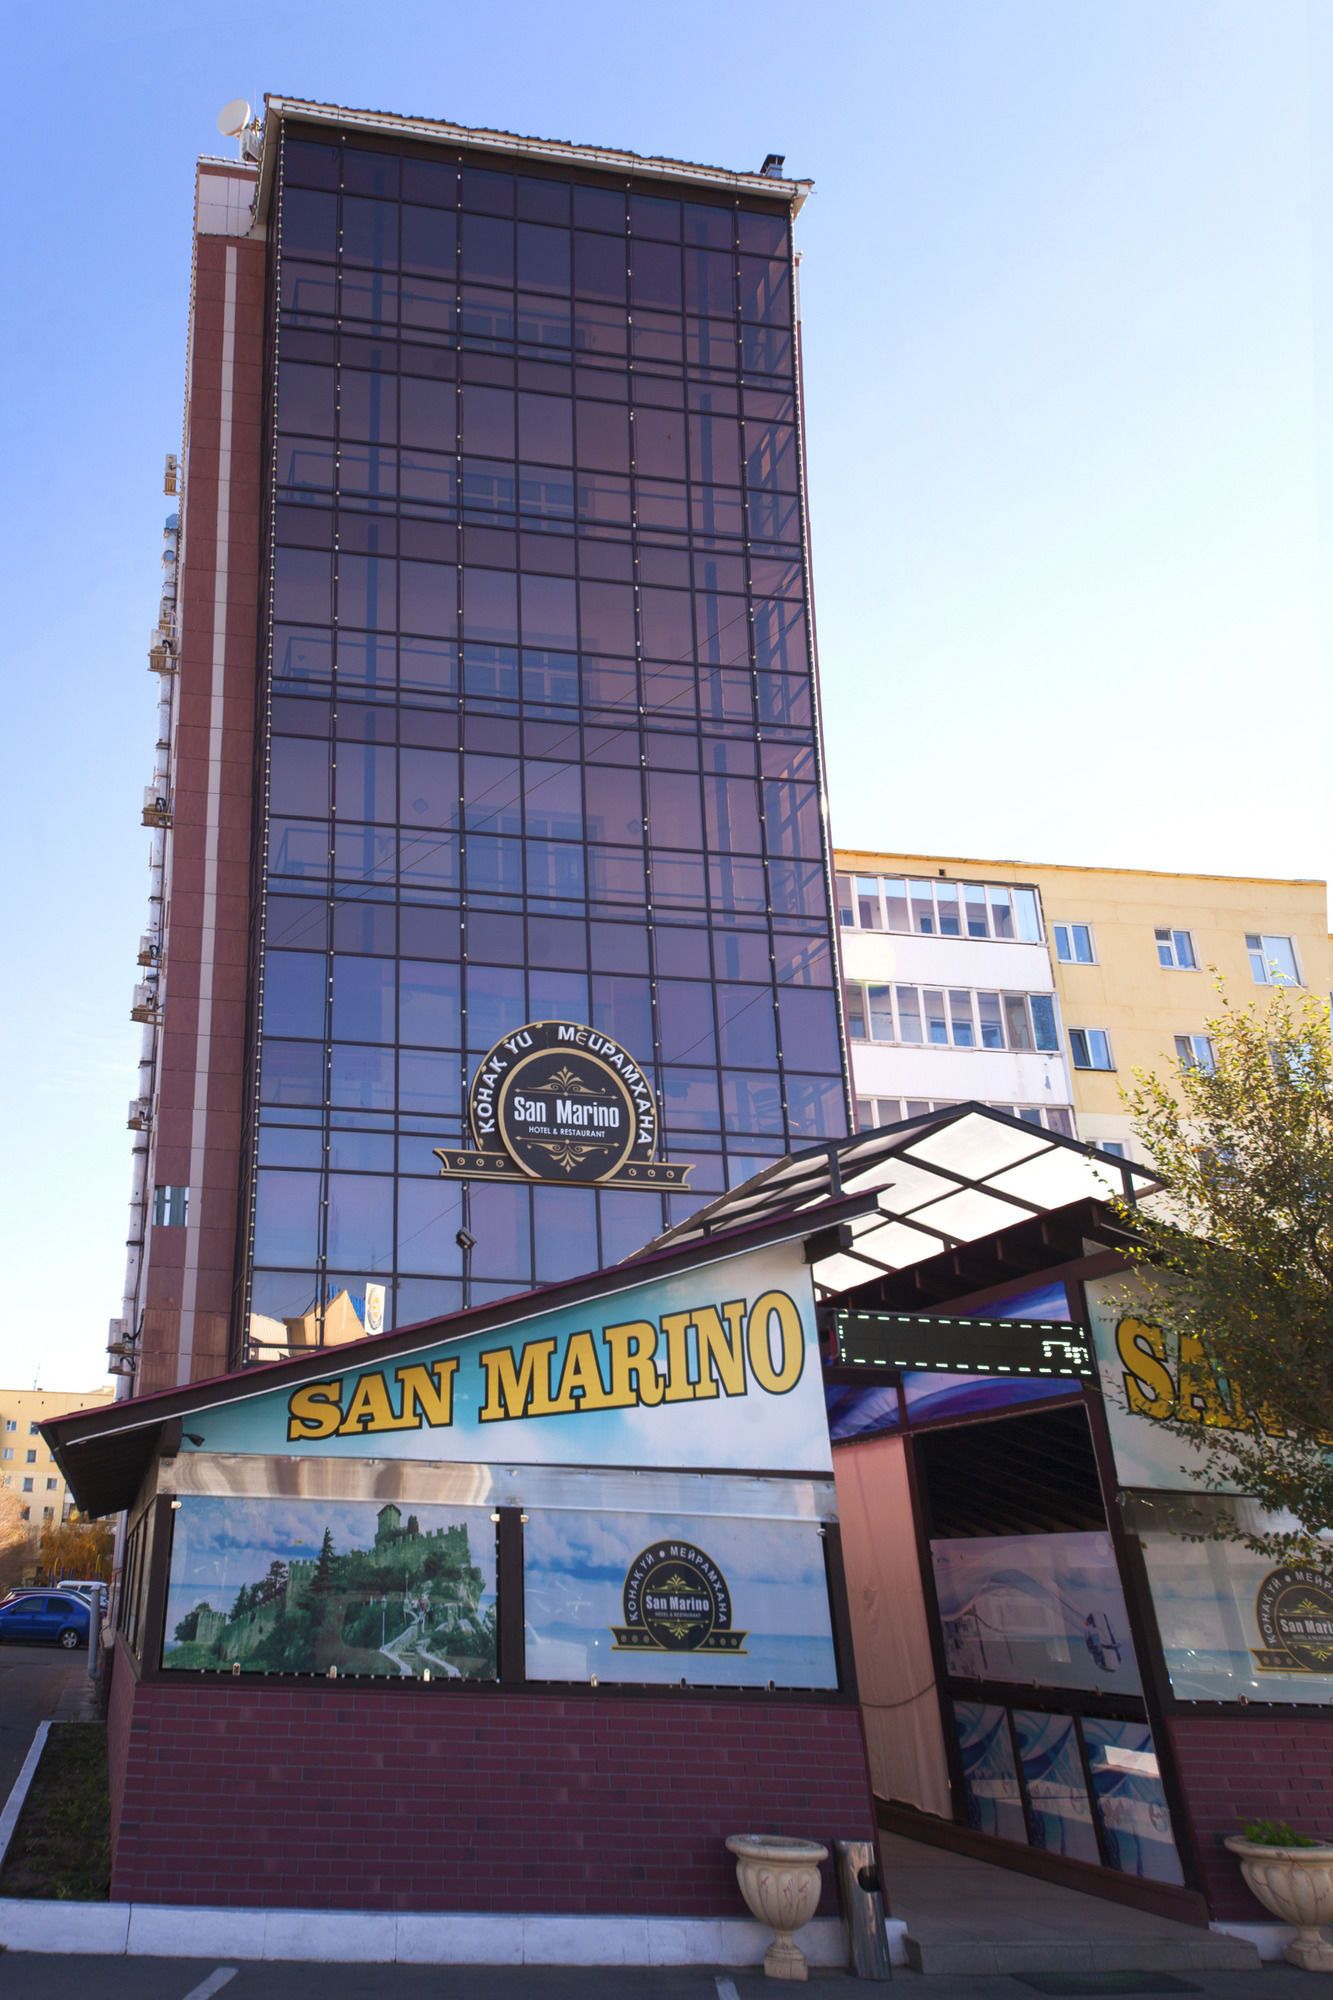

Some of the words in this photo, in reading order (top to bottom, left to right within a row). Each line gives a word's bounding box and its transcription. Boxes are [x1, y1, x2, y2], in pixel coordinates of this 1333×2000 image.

[514, 1096, 546, 1123] San
[556, 1099, 620, 1128] Marino
[528, 1126, 551, 1135] HOTEL
[560, 1128, 606, 1138] RESTAURANT
[286, 1357, 460, 1442] SAN
[478, 1289, 805, 1424] MARINO
[670, 1545, 728, 1623] МЕЙРАМХАНА
[645, 1595, 668, 1610] San
[669, 1595, 710, 1612] Marino
[1280, 1619, 1304, 1633] San
